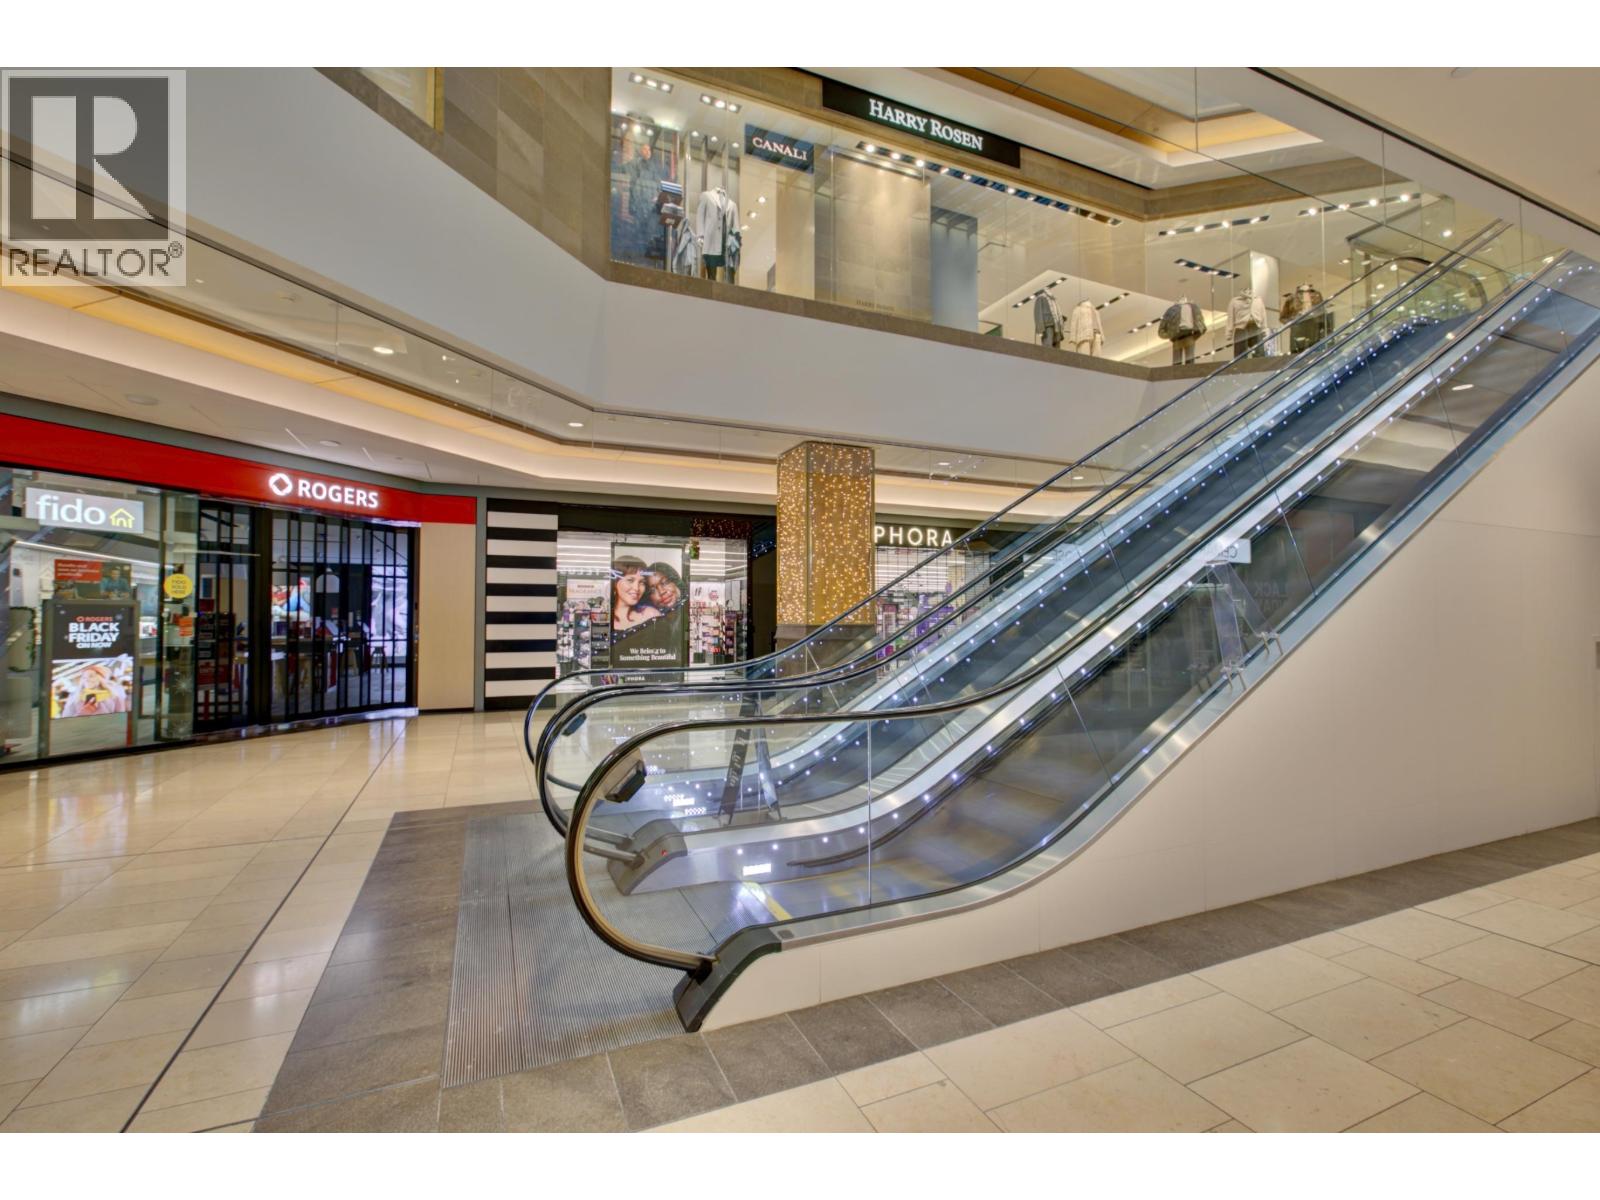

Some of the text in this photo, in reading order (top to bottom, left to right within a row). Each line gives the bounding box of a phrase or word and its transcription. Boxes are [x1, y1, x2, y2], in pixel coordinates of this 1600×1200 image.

[868, 99, 984, 151] HARRY ROSEN
[752, 136, 807, 161] CANALI
[298, 479, 378, 508] ROGERS
[36, 494, 106, 525] fido
[68, 632, 119, 642] FRIDAY
[69, 622, 119, 632] BLACK
